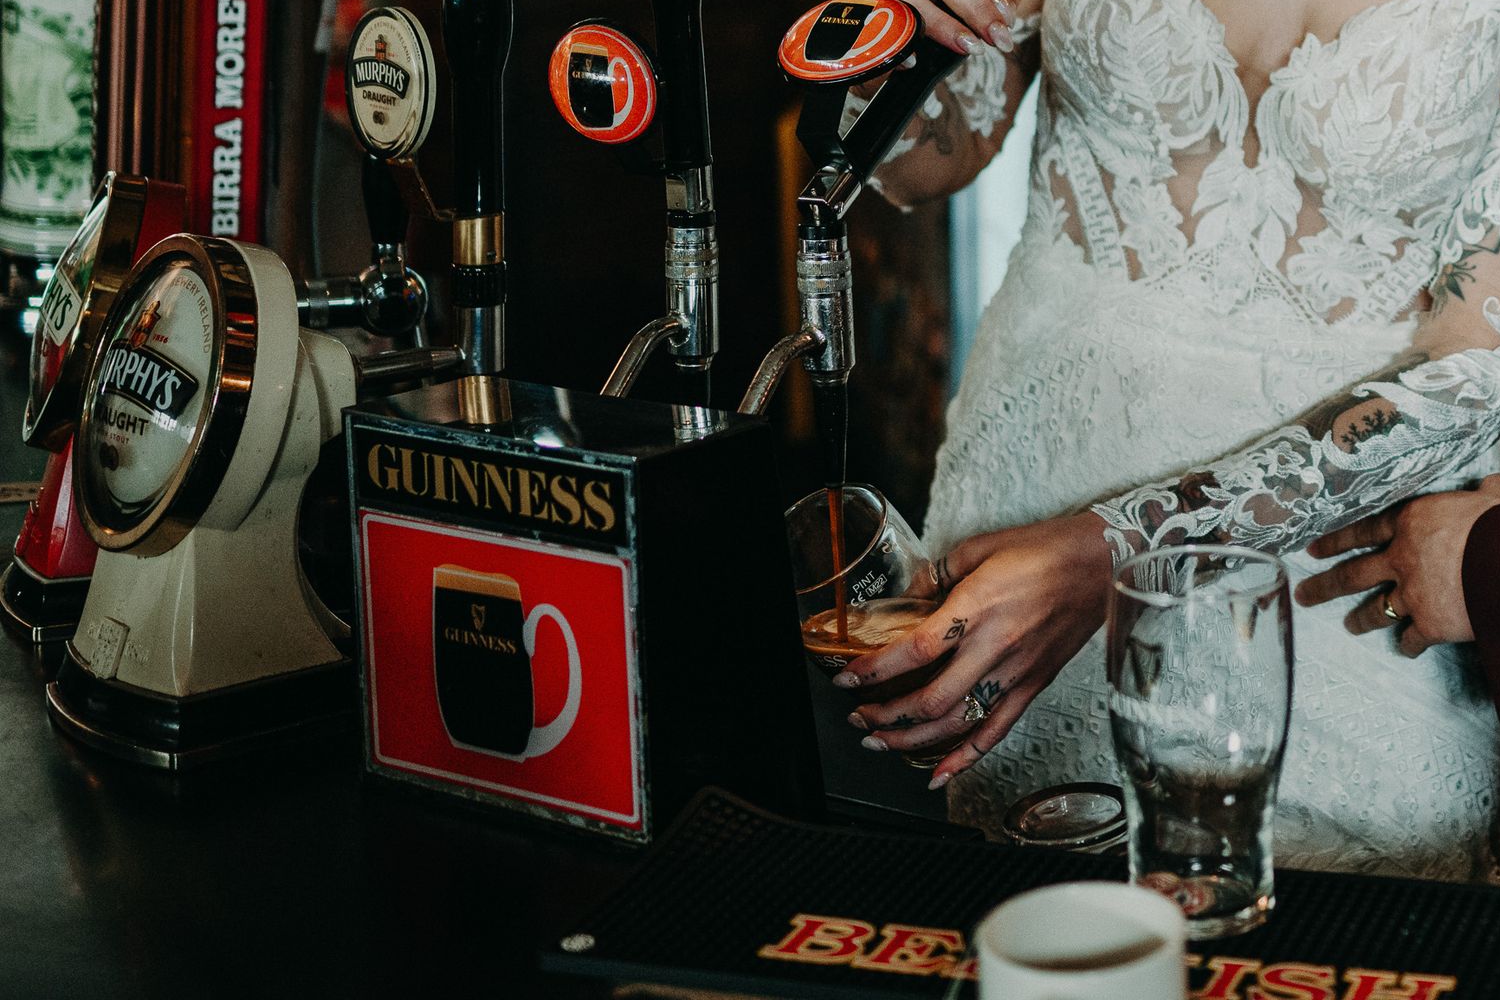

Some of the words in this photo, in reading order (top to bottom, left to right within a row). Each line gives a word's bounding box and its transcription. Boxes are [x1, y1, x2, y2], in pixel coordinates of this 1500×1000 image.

[820, 15, 861, 26] GUINNESS
[354, 60, 407, 93] MURPHY'S
[361, 88, 398, 108] DRAUGHT
[211, 116, 243, 238] BIRRA
[152, 332, 170, 345] 1856
[198, 296, 212, 355] IRELAND
[102, 406, 150, 437] AUGHT
[367, 442, 617, 533] GUINNESS
[851, 569, 877, 595] PINT
[865, 572, 888, 598] M22
[444, 626, 518, 656] GUINNESS
